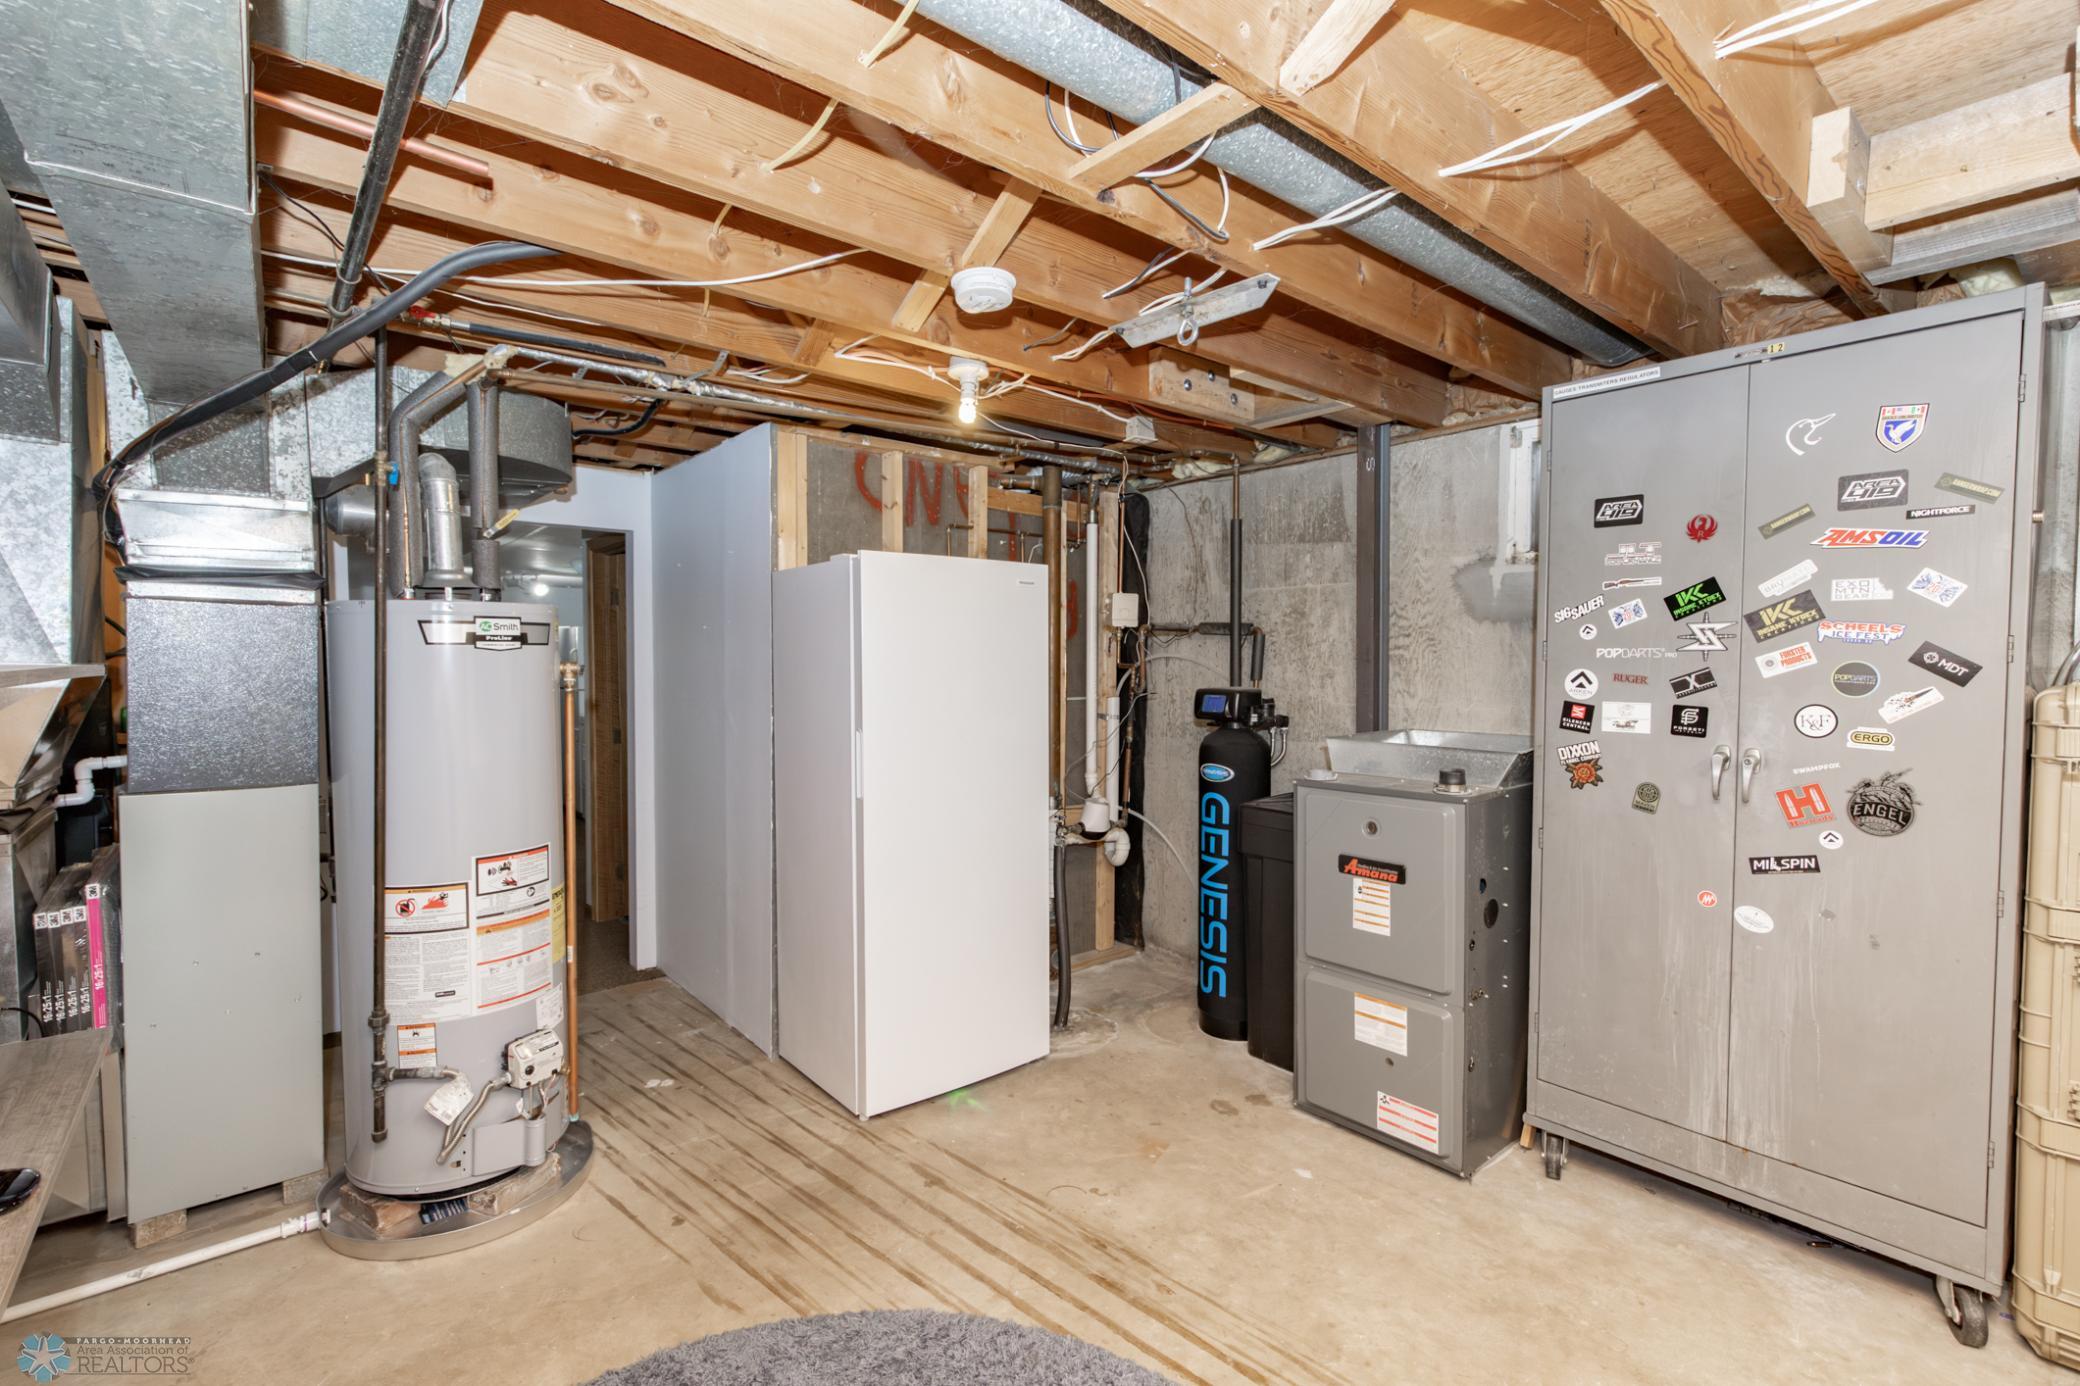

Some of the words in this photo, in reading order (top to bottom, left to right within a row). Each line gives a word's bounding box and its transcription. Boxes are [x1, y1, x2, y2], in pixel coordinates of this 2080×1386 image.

[1911, 506, 1970, 517] NIGHTFORCE
[1819, 529, 1928, 547] AMSOIL
[1554, 606, 1573, 623] SIG
[1571, 595, 1605, 620] SAUER
[493, 622, 519, 631] Smith
[1820, 621, 1902, 633] SCHEELS
[1832, 631, 1851, 639] ICE
[1596, 648, 1663, 658] POPDARTS
[1937, 658, 1969, 677] MDT
[1613, 673, 1648, 685] RUGER
[1853, 733, 1890, 743] ERGO
[1557, 740, 1600, 760] DIXXON
[1793, 762, 1841, 775] SWAMPFOX
[1852, 803, 1907, 826] ENGEL
[1344, 858, 1398, 882] Amana
[1200, 792, 1230, 998] GENESIS
